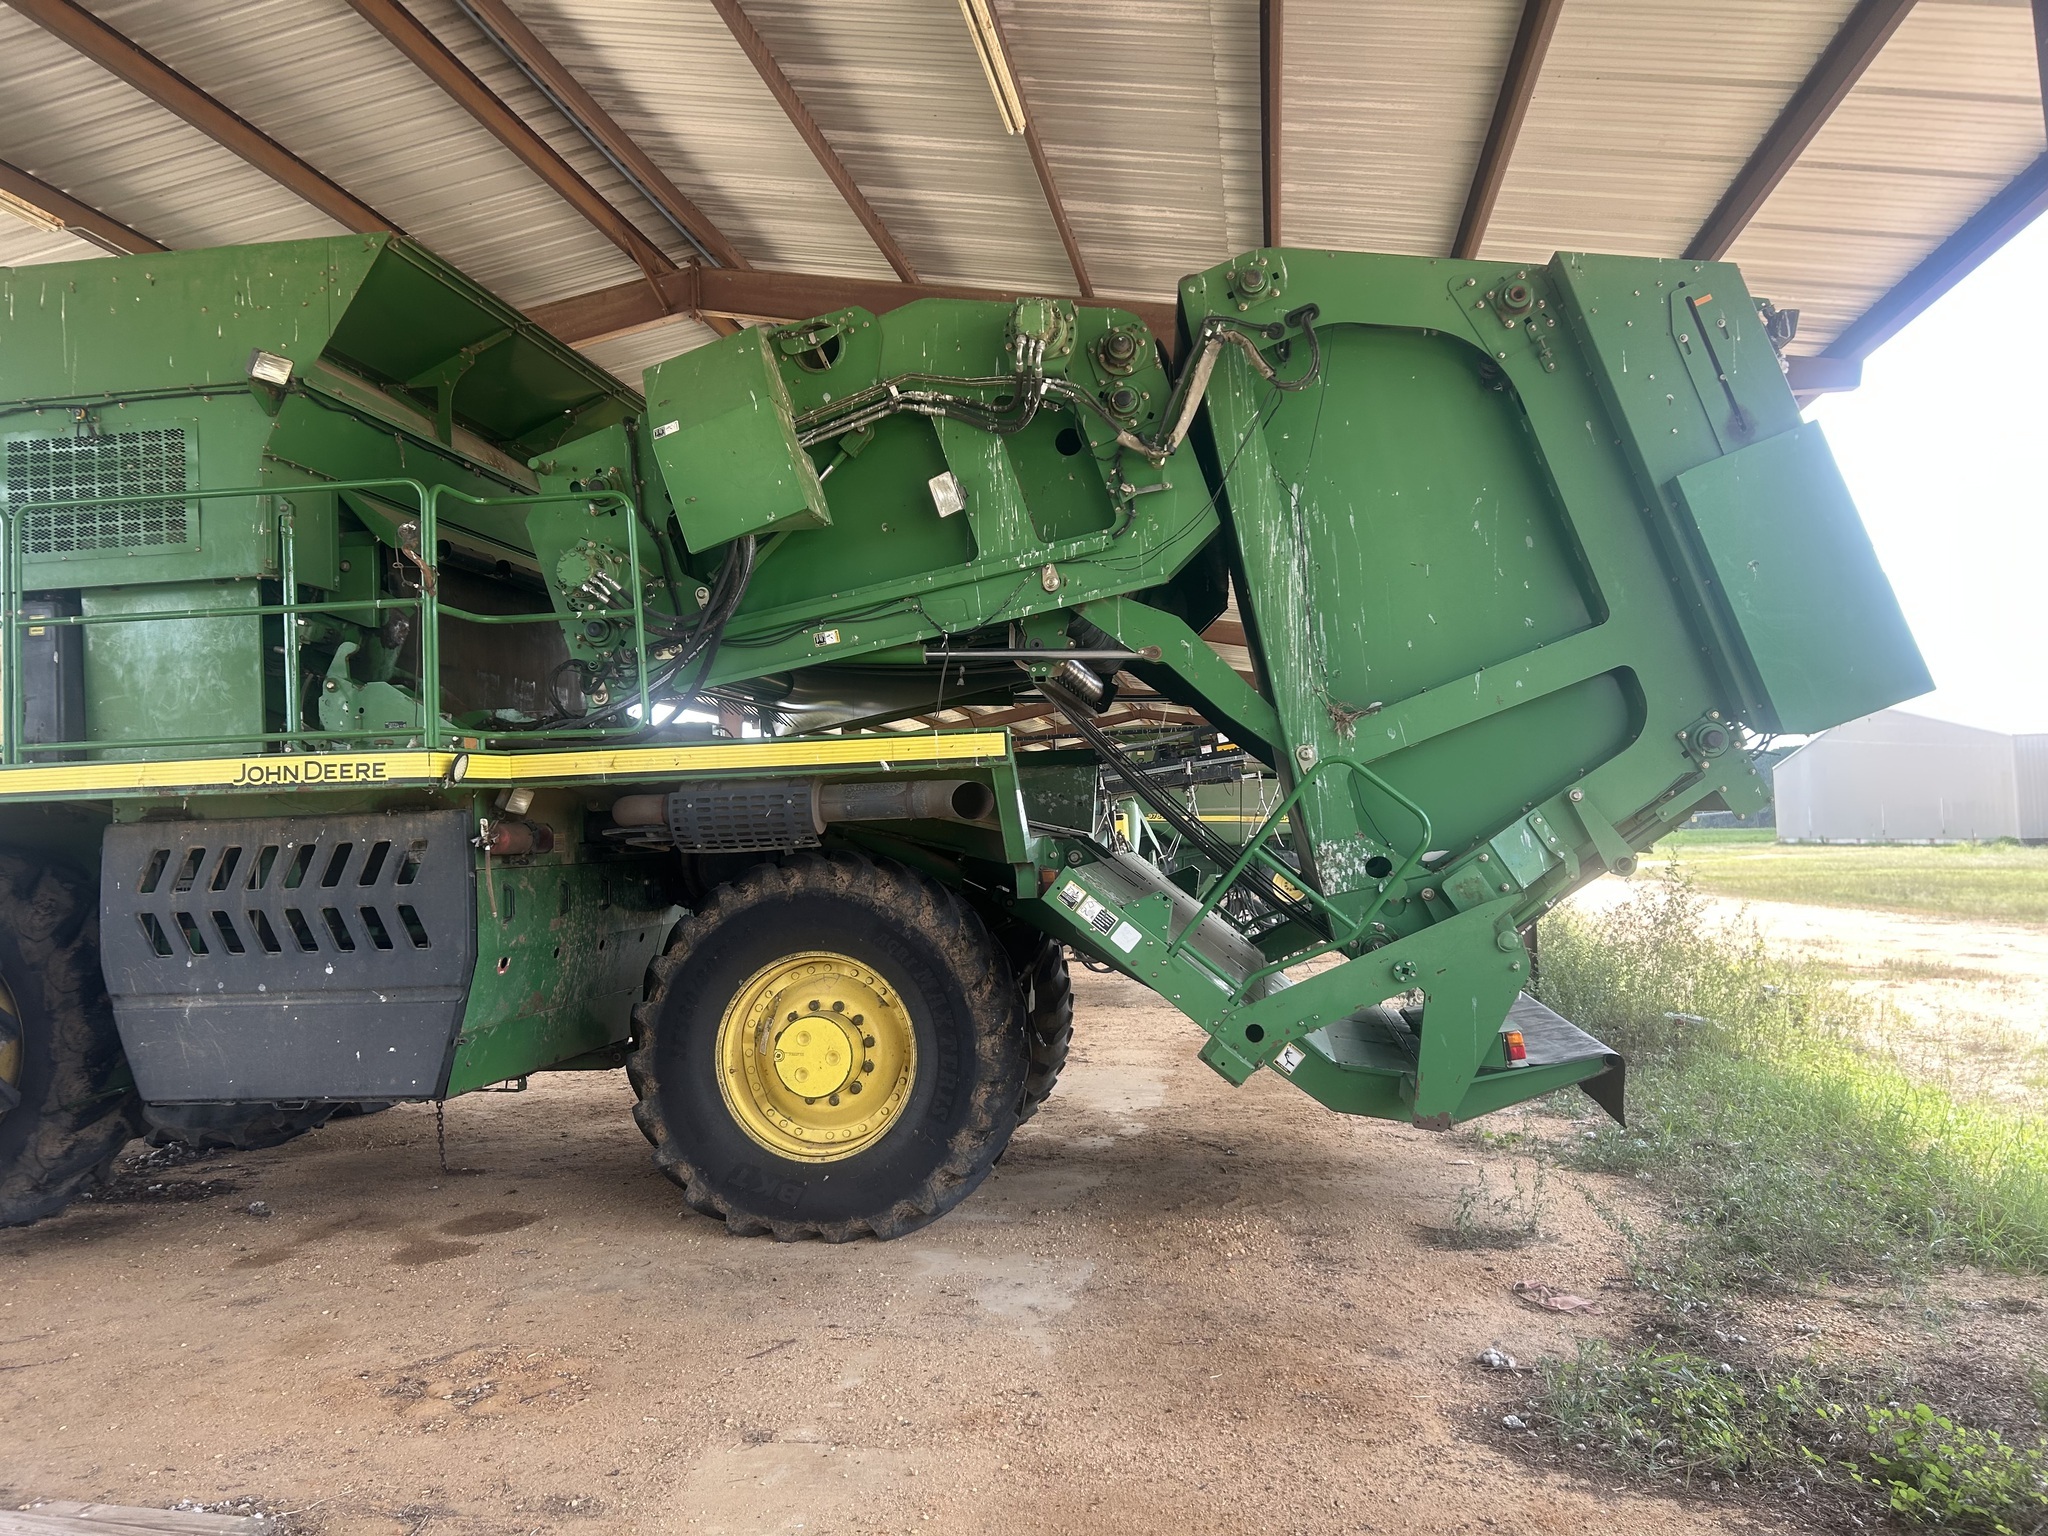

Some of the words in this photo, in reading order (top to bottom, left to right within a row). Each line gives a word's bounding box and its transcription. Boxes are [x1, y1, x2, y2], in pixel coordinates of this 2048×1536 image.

[233, 763, 299, 783] JOHN
[304, 760, 387, 781] DEERE
[728, 1167, 804, 1206] BKT
